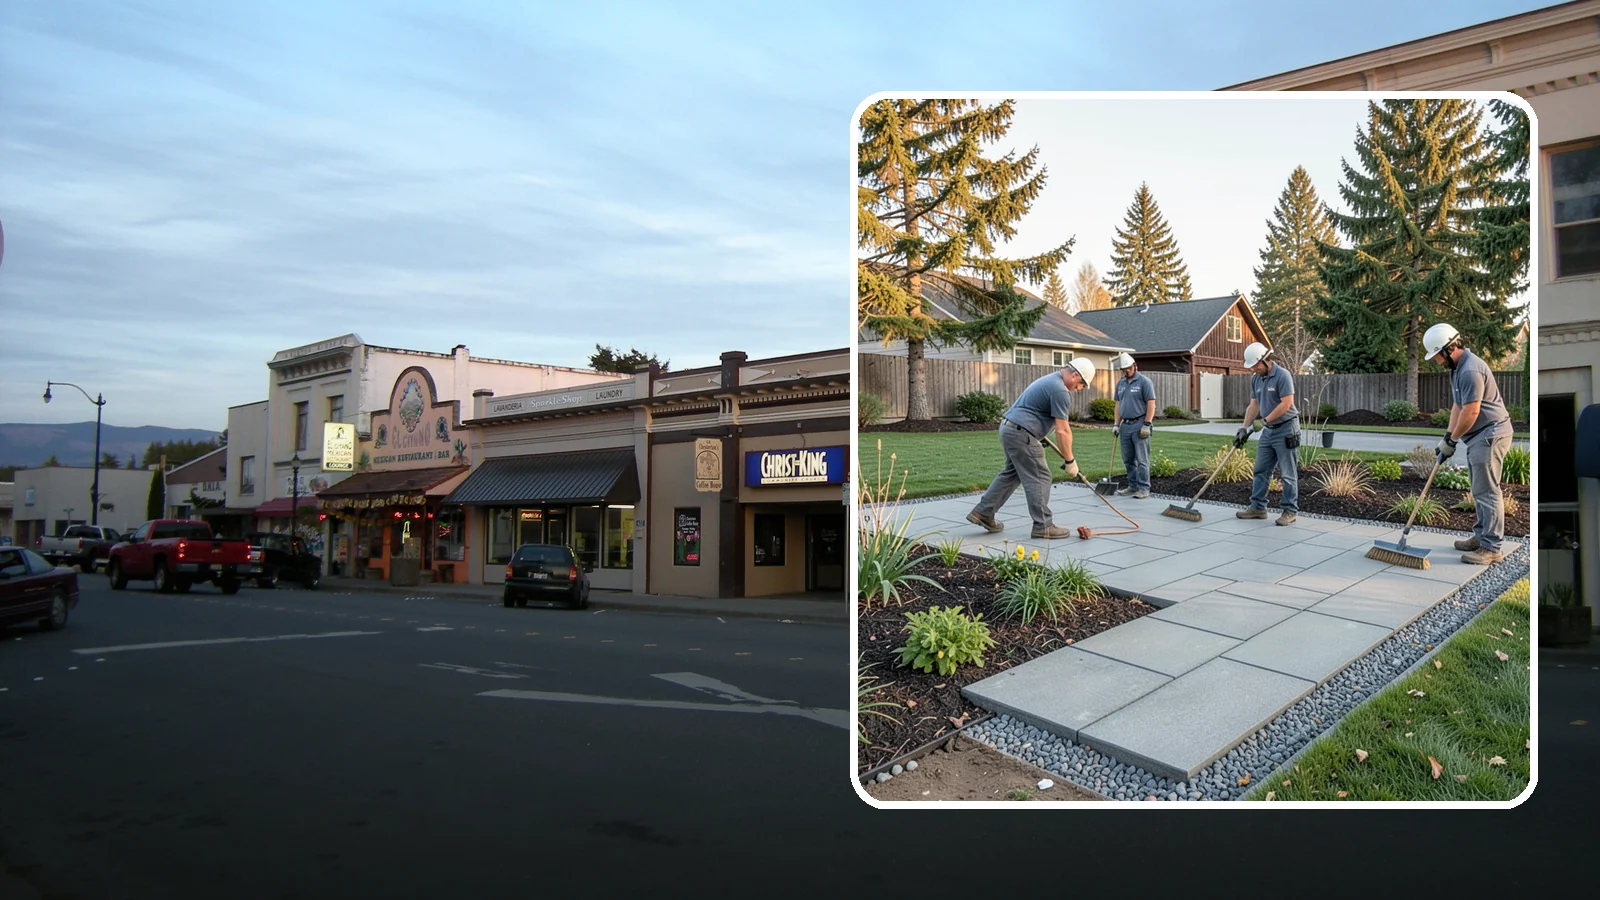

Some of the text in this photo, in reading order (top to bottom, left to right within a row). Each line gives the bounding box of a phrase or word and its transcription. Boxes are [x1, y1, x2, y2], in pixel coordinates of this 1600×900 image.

[493, 402, 522, 413] LAVANDERIA
[561, 394, 582, 404] Shop
[595, 389, 624, 400] LAUNDRY
[397, 451, 433, 463] RESTAURANT
[438, 450, 450, 459] BAR
[696, 480, 709, 488] Coffee
